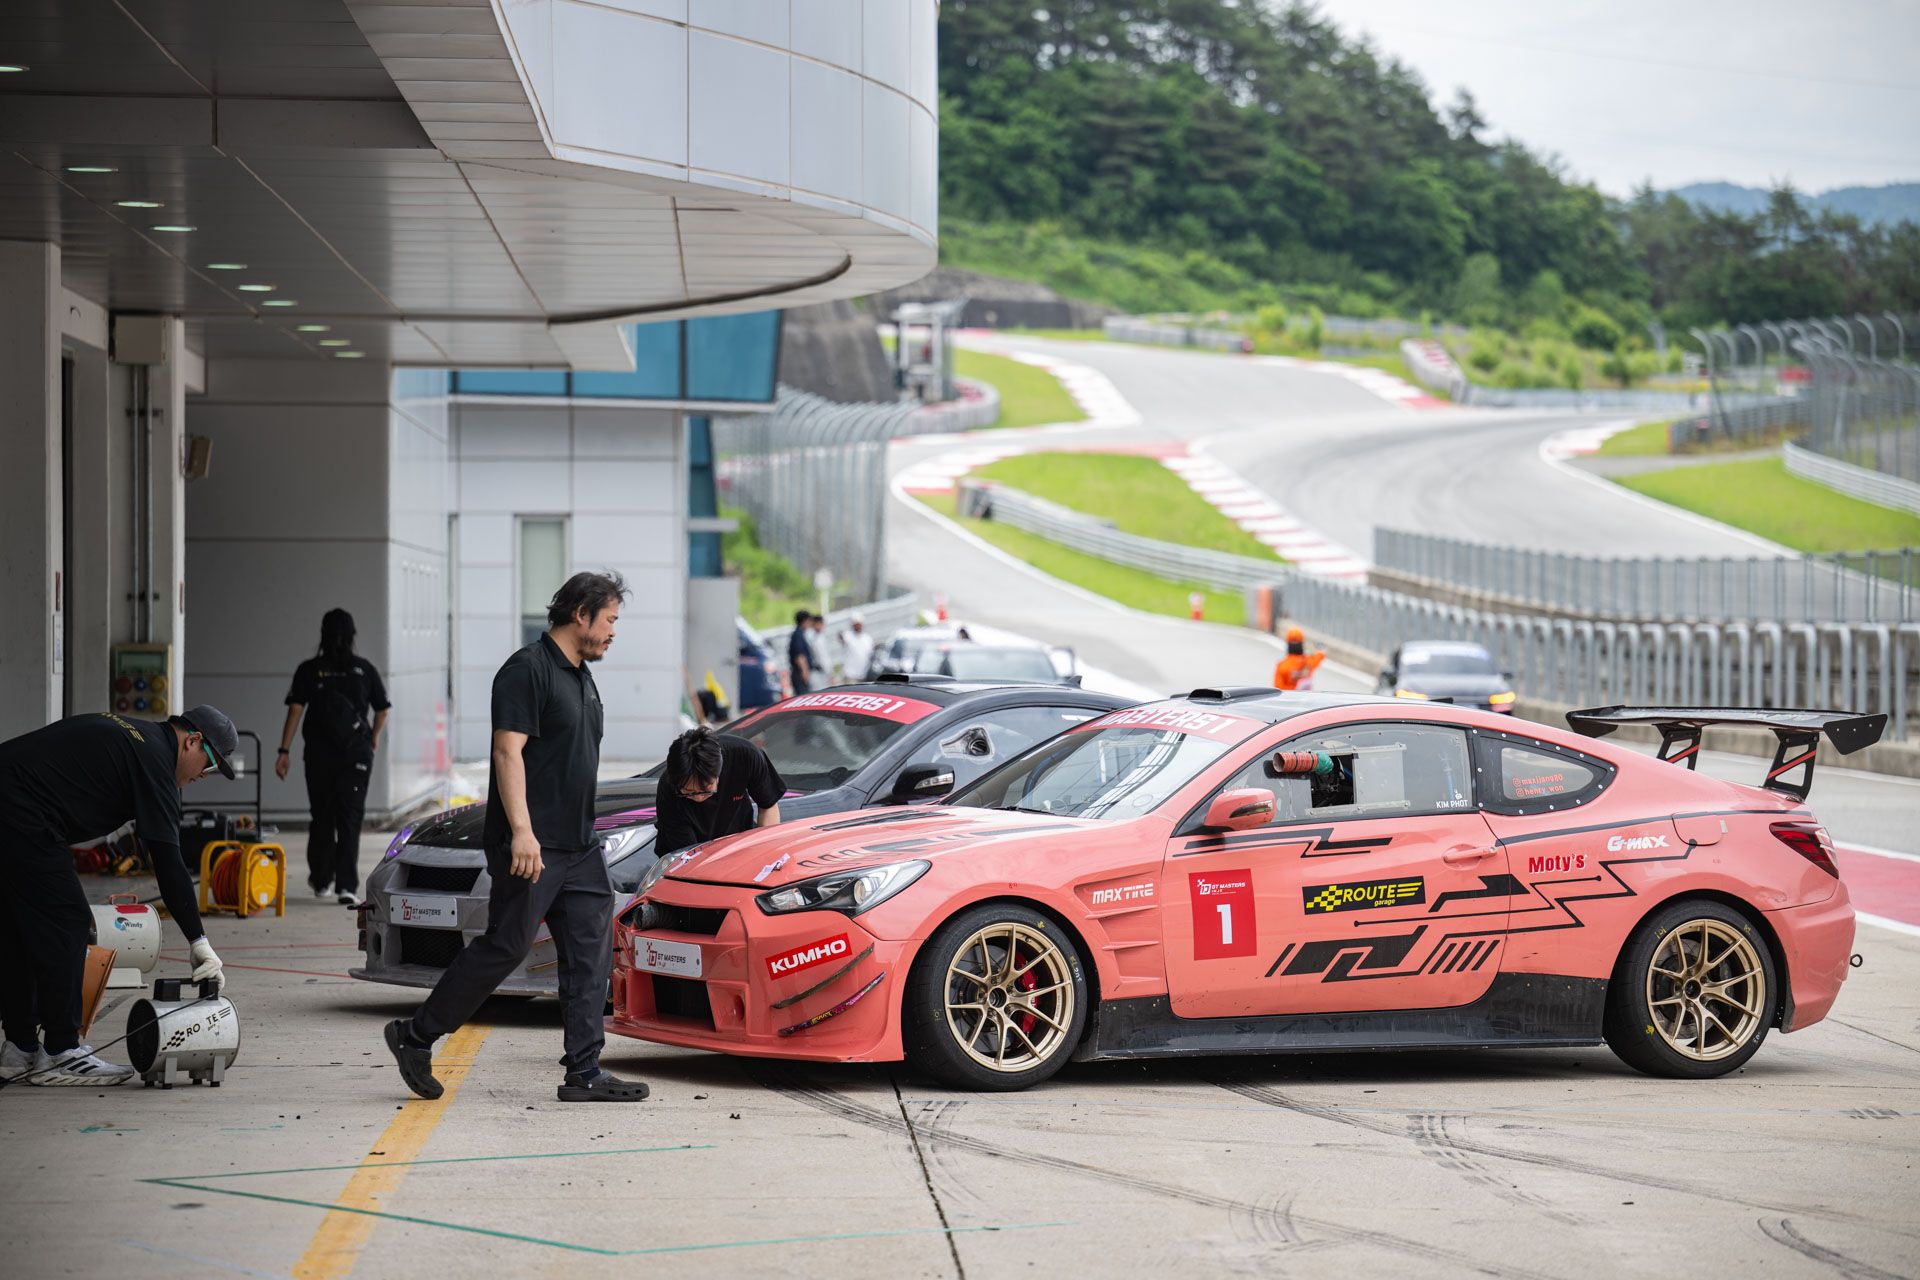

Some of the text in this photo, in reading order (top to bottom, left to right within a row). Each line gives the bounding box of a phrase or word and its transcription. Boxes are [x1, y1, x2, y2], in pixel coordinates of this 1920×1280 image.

[781, 694, 906, 714] MASTERS 1
[1090, 709, 1238, 734] MASTERS 1
[1435, 799, 1469, 809] KIM PHOT
[1528, 854, 1587, 873] Moty's
[1342, 884, 1397, 903] ROUTE
[1374, 898, 1396, 907] garage
[419, 908, 442, 916] MASTERS
[124, 921, 143, 929] Windy
[1216, 903, 1233, 945] 1
[663, 953, 687, 964] MASTERS
[770, 939, 847, 974] KUMHO
